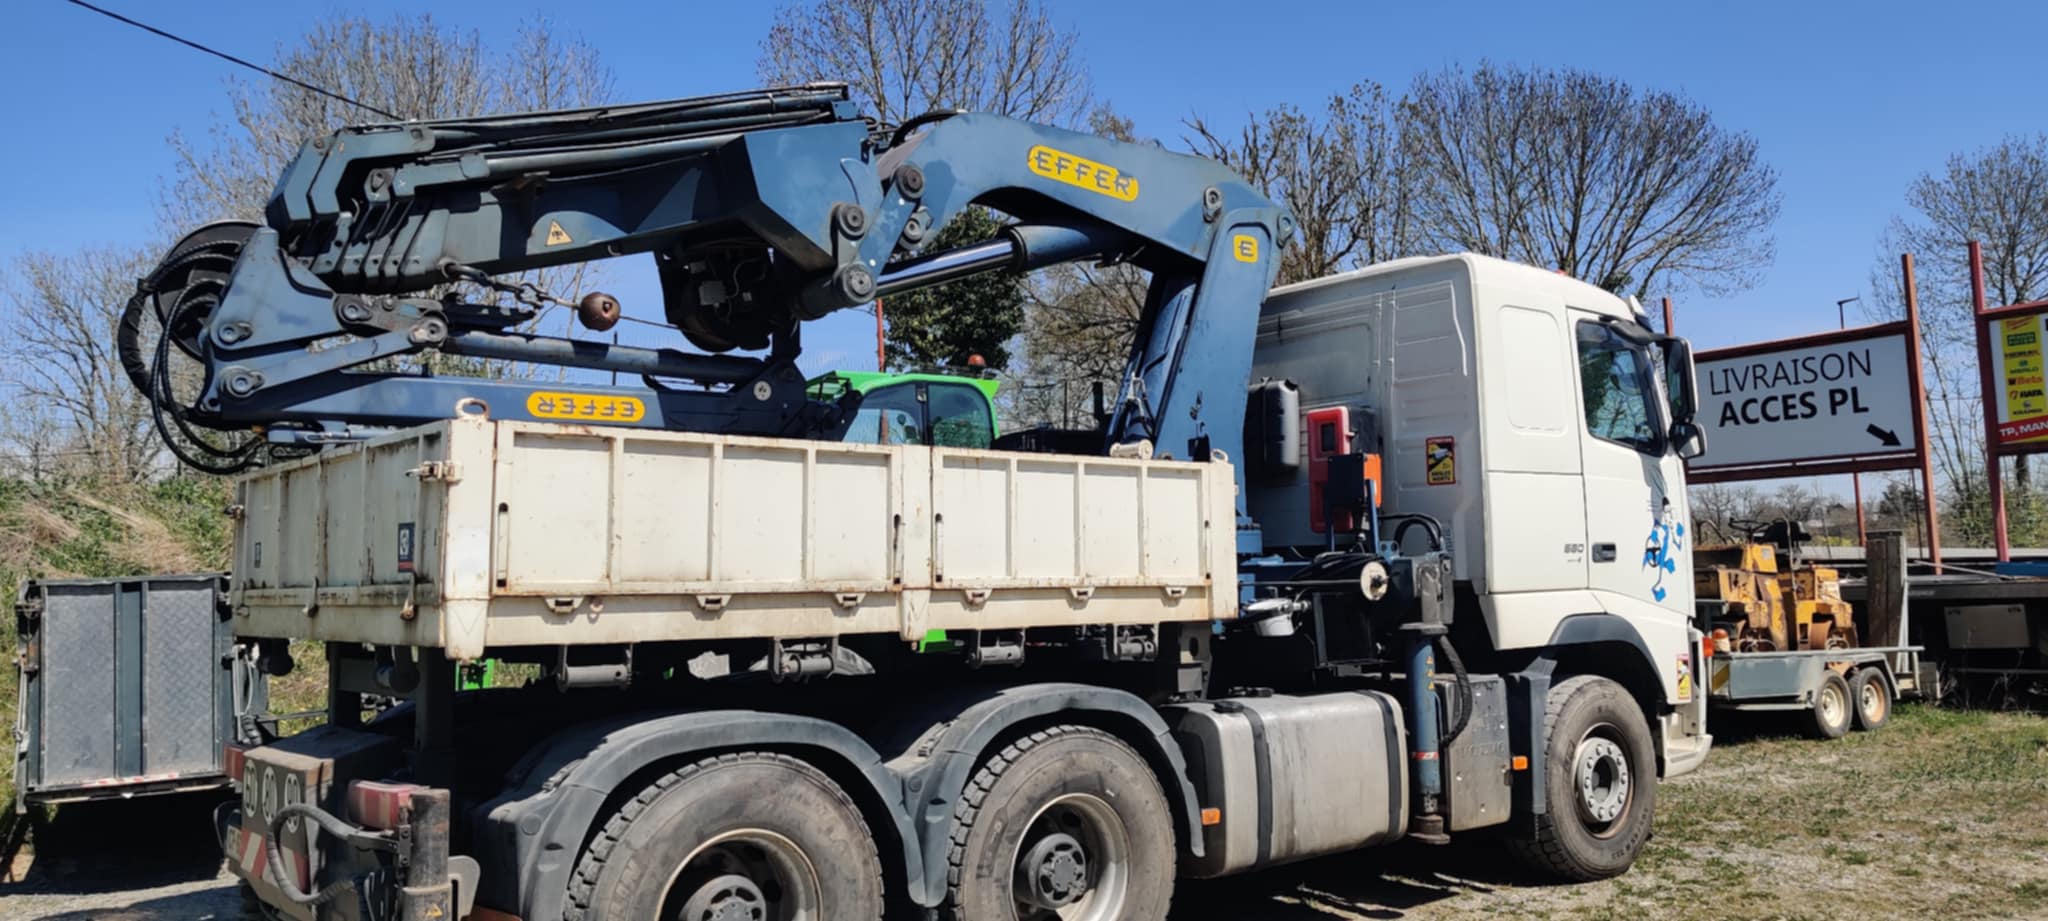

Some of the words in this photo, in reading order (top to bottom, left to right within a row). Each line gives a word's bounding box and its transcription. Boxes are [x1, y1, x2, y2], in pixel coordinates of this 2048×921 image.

[1034, 150, 1131, 196] EFFER
[1238, 240, 1255, 257] E
[1709, 348, 1871, 395] LIVRAISON
[537, 397, 637, 417] EFFER
[1718, 391, 1818, 427] ACCES
[1828, 386, 1869, 416] PL
[1999, 427, 2019, 438] TP,
